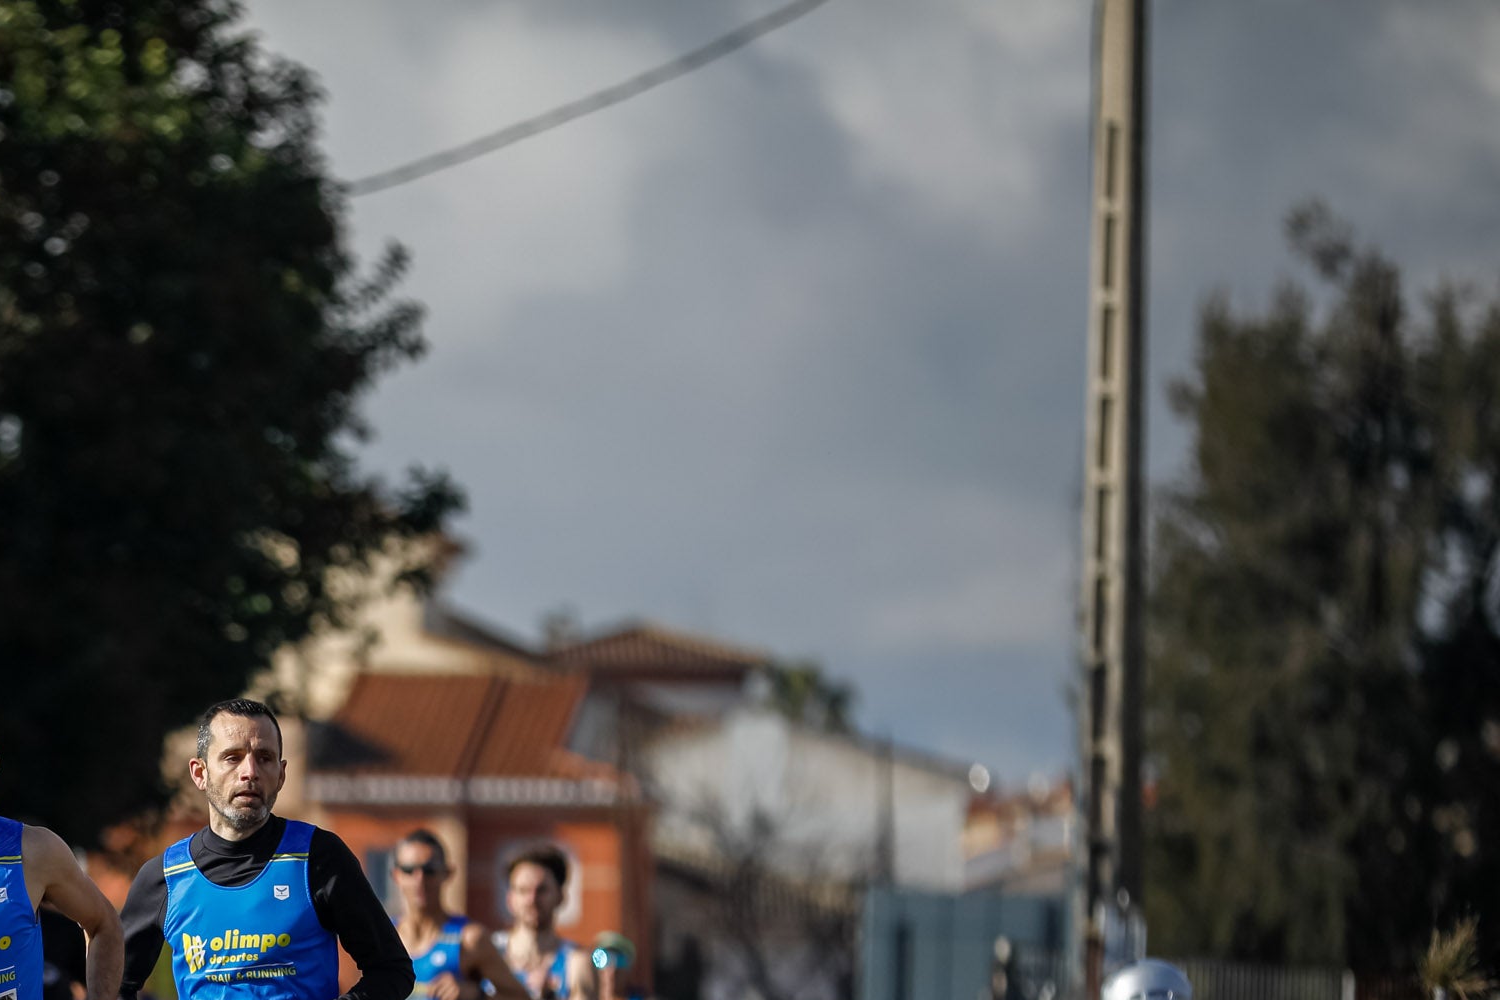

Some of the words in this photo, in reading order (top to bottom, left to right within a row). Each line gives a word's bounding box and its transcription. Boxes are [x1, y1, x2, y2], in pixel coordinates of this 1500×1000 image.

[210, 929, 291, 953] olimpo
[209, 953, 259, 966] deportes
[206, 974, 232, 982] TRAIL
[246, 967, 297, 979] RUNNING
